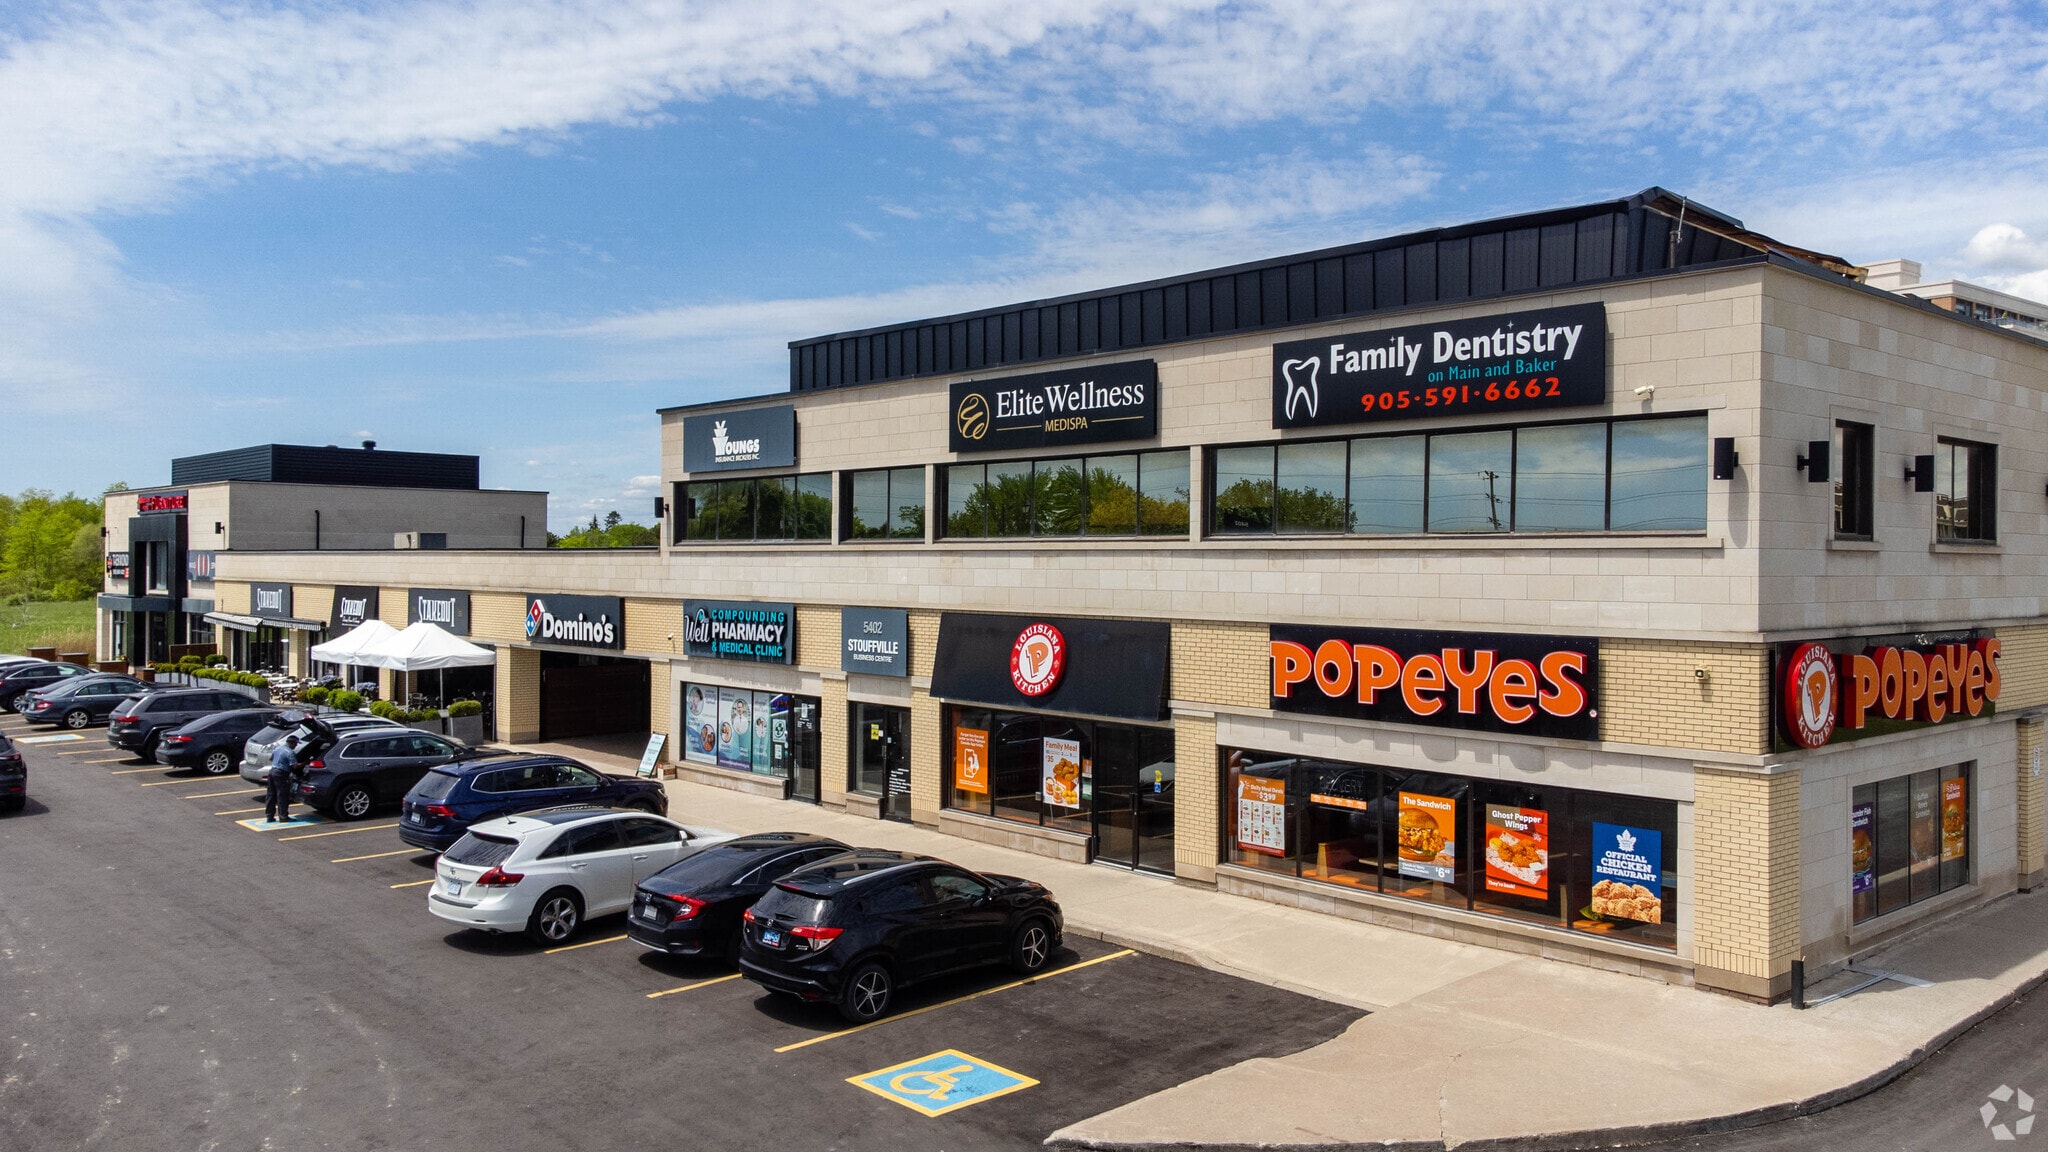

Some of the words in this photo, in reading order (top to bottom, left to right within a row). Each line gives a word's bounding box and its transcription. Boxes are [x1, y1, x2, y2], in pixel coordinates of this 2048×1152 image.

[1329, 336, 1422, 376] Family
[1433, 322, 1583, 363] Dentistry
[1427, 370, 1444, 382] on
[1449, 365, 1480, 381] Main
[1485, 361, 1510, 377] and
[1516, 360, 1557, 375] Baker
[1045, 417, 1088, 432] MEDISPA
[712, 430, 760, 456] YOUNGS
[418, 596, 455, 627] STAKEOUT
[711, 609, 785, 623] COMPOUNDING
[542, 612, 614, 643] Domino's
[711, 622, 785, 643] PHARMACY
[863, 621, 883, 635] 5402
[848, 638, 899, 655] STOUFFVILLE
[1015, 624, 1061, 653] LOUISIANA
[711, 641, 718, 652] &
[719, 642, 754, 655] MEDICAL
[755, 644, 783, 657] CLINIC
[1797, 645, 1837, 686] LOUISIANA
[1012, 668, 1056, 693] KITCHEN
[1797, 710, 1835, 747] KITCHEN
[1402, 796, 1416, 805] The
[1416, 799, 1451, 811] Sandwich
[1491, 810, 1513, 819] Ghost
[1514, 813, 1541, 824] Pepper
[1504, 820, 1528, 831] Wings
[1600, 857, 1652, 874] CHICKEN
[1605, 850, 1648, 864] OFFICIAL
[1596, 865, 1657, 882] RESTAURANT
